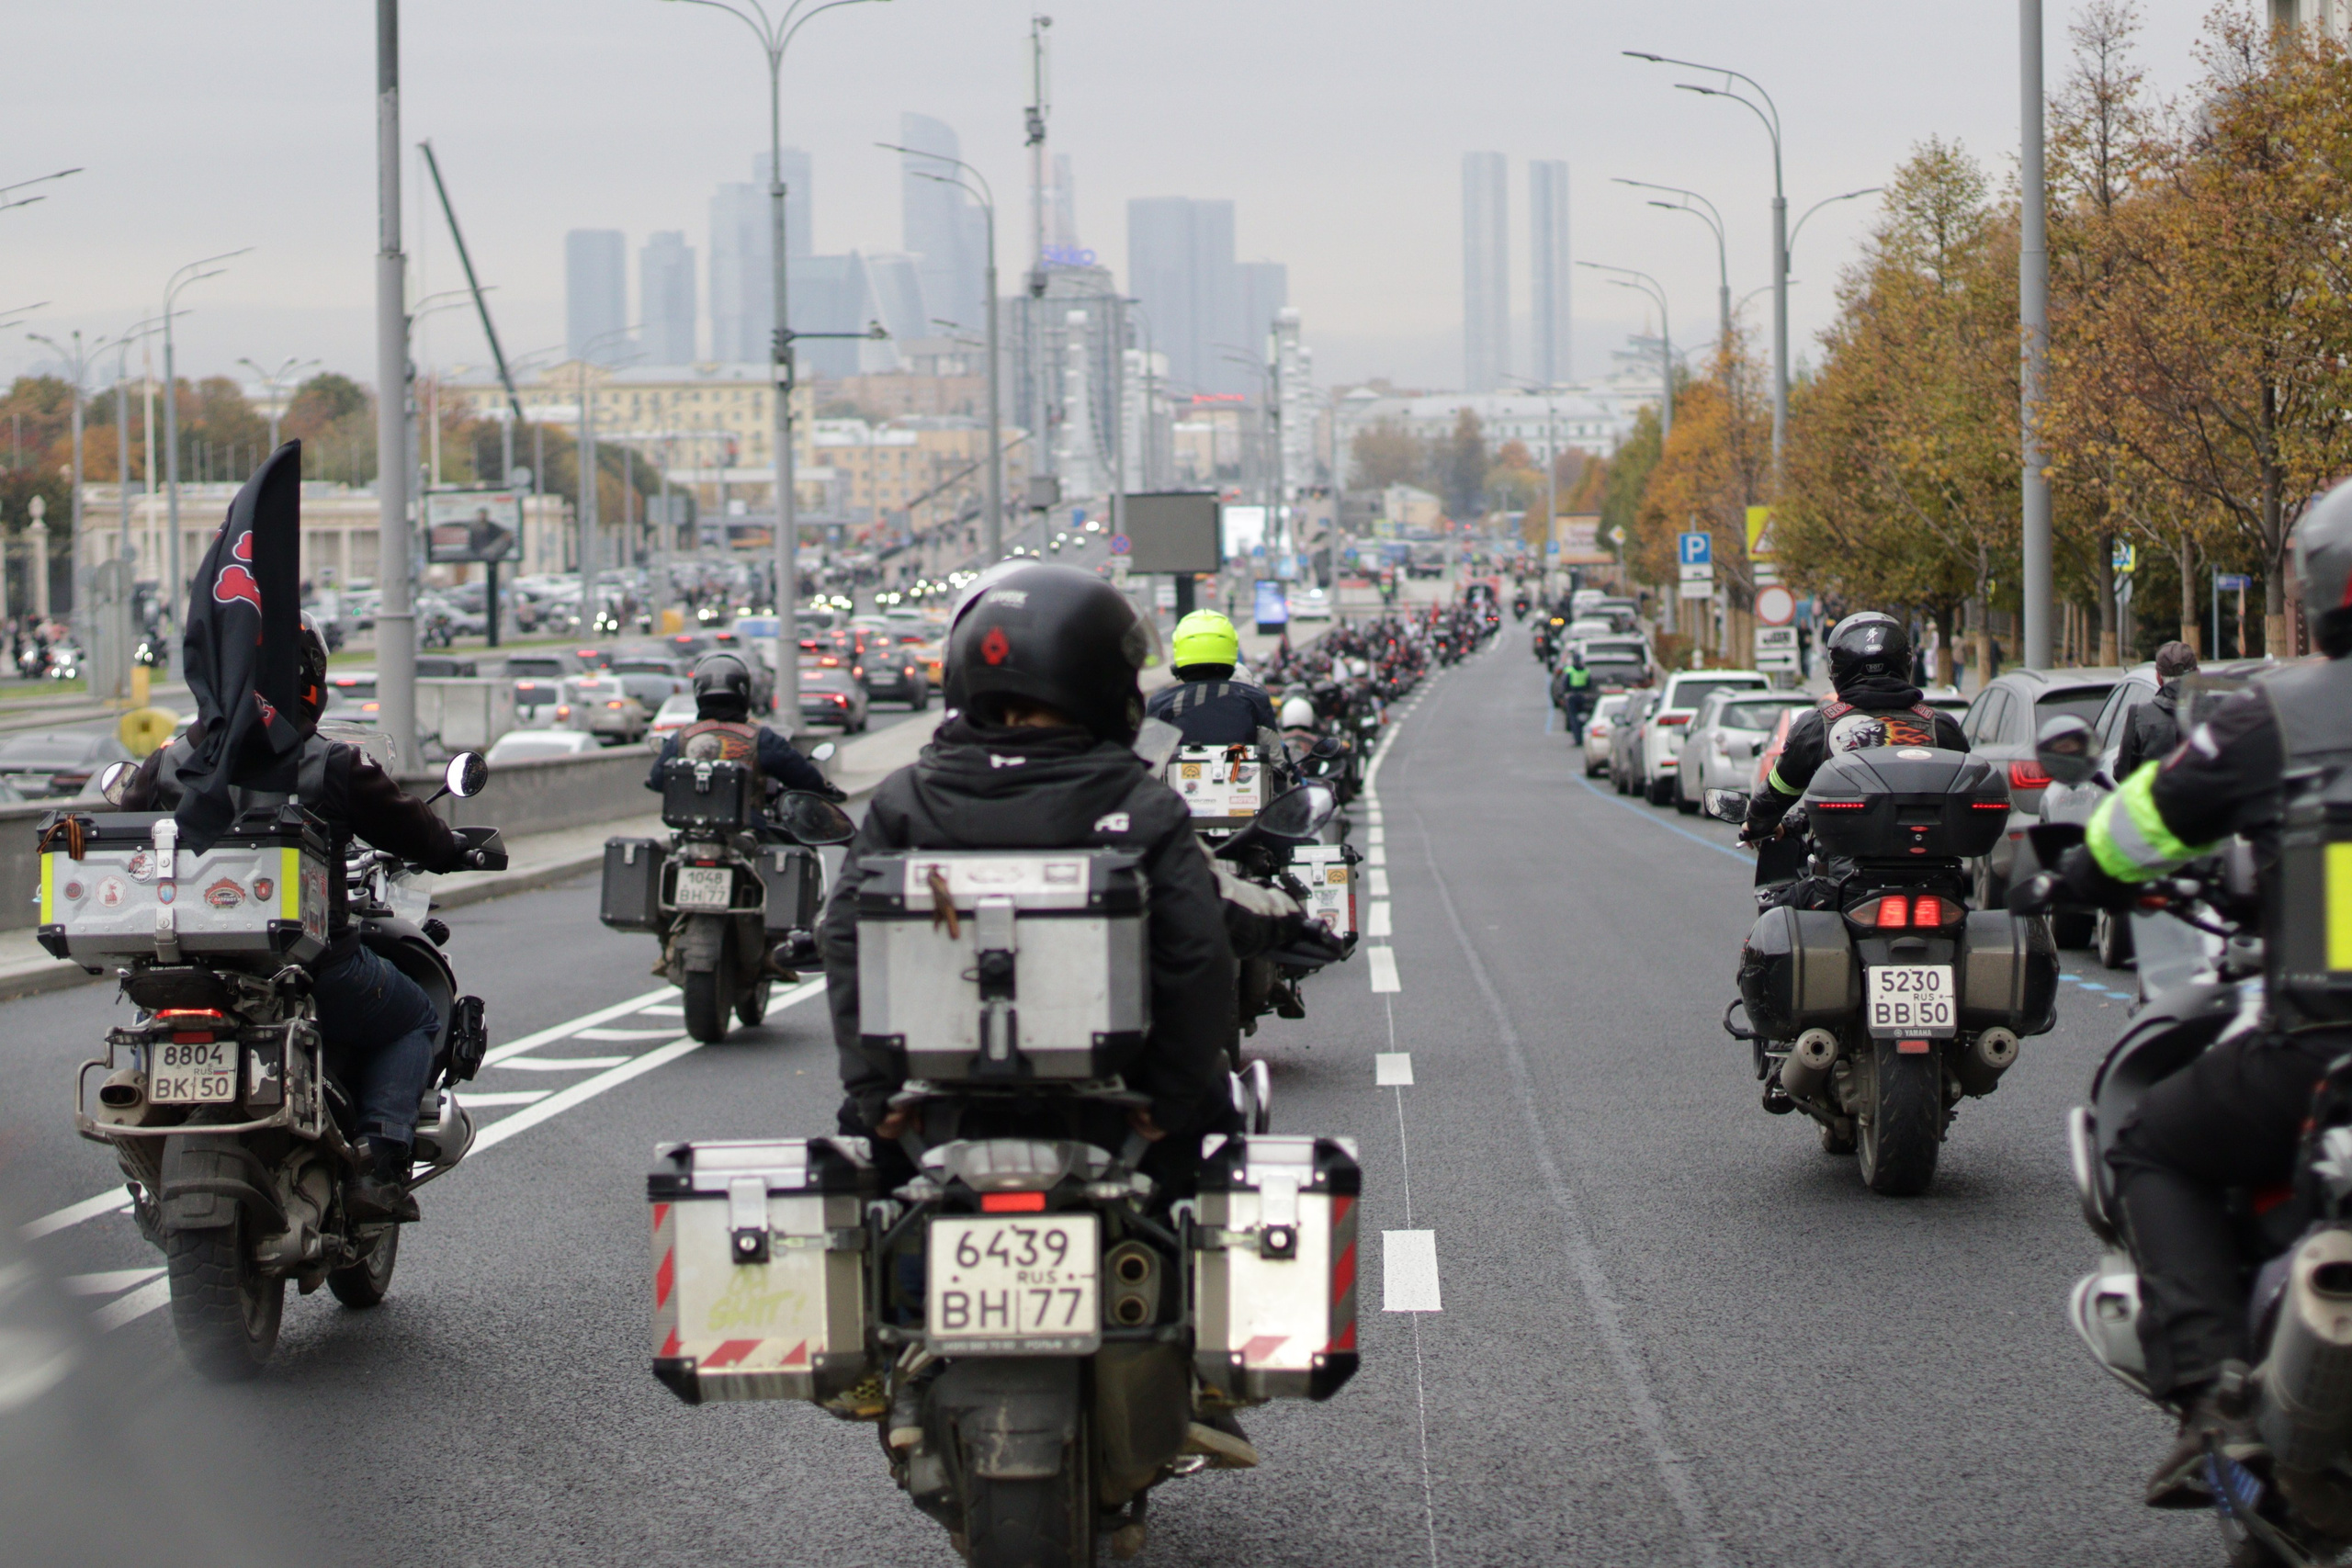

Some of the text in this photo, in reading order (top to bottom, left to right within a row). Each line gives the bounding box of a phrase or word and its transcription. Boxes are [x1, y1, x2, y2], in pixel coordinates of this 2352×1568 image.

[1686, 535, 1706, 561] P
[687, 872, 724, 886] 1048
[707, 889, 726, 903] 77
[1881, 970, 1940, 992] 5230
[1913, 993, 1935, 1001] RUS
[1919, 1002, 1949, 1023] 50
[1905, 1029, 1932, 1037] YAMAHA
[164, 1044, 223, 1066] 8804
[194, 1067, 213, 1076] RUS
[200, 1077, 229, 1098] 50
[956, 1228, 1069, 1269] 6439
[1016, 1269, 1057, 1284] RUS
[1028, 1287, 1082, 1327] 77
